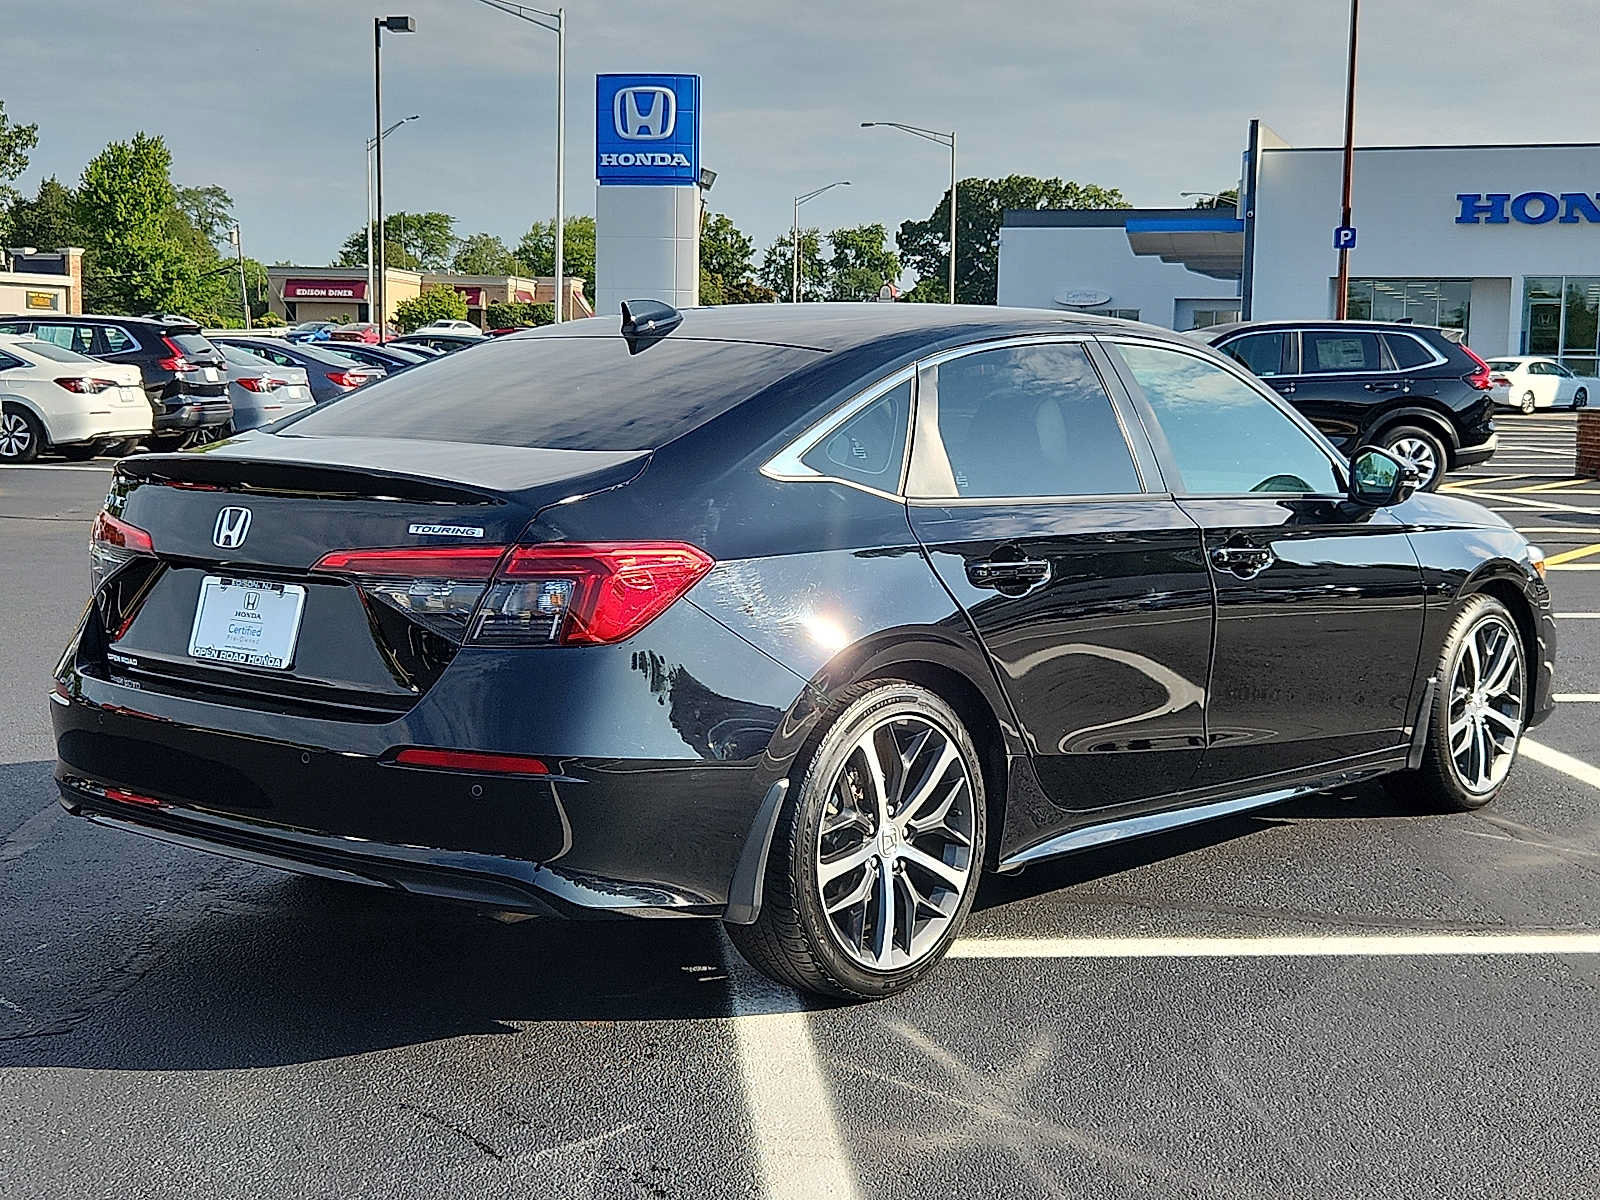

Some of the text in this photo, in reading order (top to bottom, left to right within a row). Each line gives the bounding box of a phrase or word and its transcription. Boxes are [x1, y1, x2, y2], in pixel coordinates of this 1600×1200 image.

[600, 153, 690, 166] HONDA
[1340, 230, 1352, 245] P
[296, 288, 353, 297] EDISON DINER
[414, 525, 477, 536] TOURING
[234, 610, 262, 620] HONDA
[228, 623, 262, 637] Certified
[194, 647, 219, 658] OPEN
[219, 650, 247, 662] ROAD
[248, 655, 282, 668] HONDA
